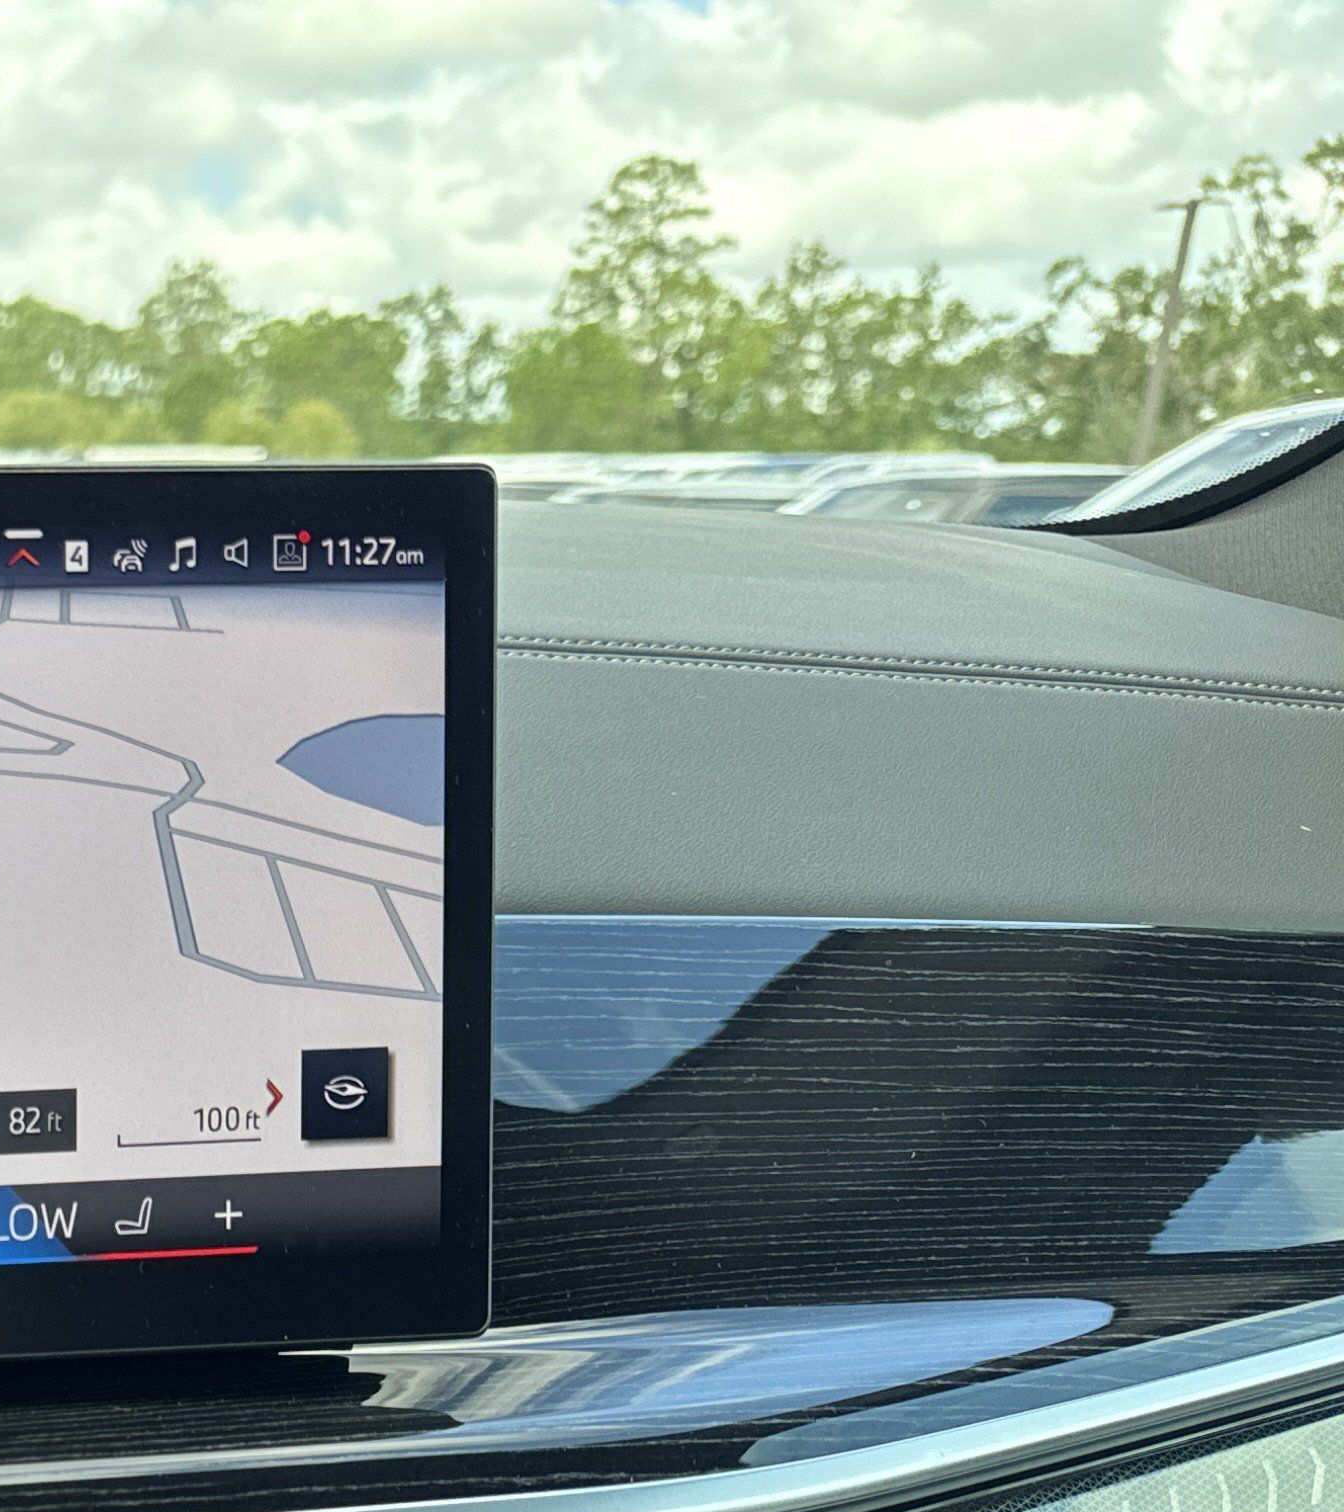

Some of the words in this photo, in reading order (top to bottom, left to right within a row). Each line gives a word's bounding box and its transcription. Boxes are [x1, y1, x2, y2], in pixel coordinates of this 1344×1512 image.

[70, 545, 83, 567] 4
[9, 1106, 41, 1135] 82
[47, 1111, 63, 1132] ft
[193, 1106, 240, 1132] 100
[246, 1110, 261, 1131] ft
